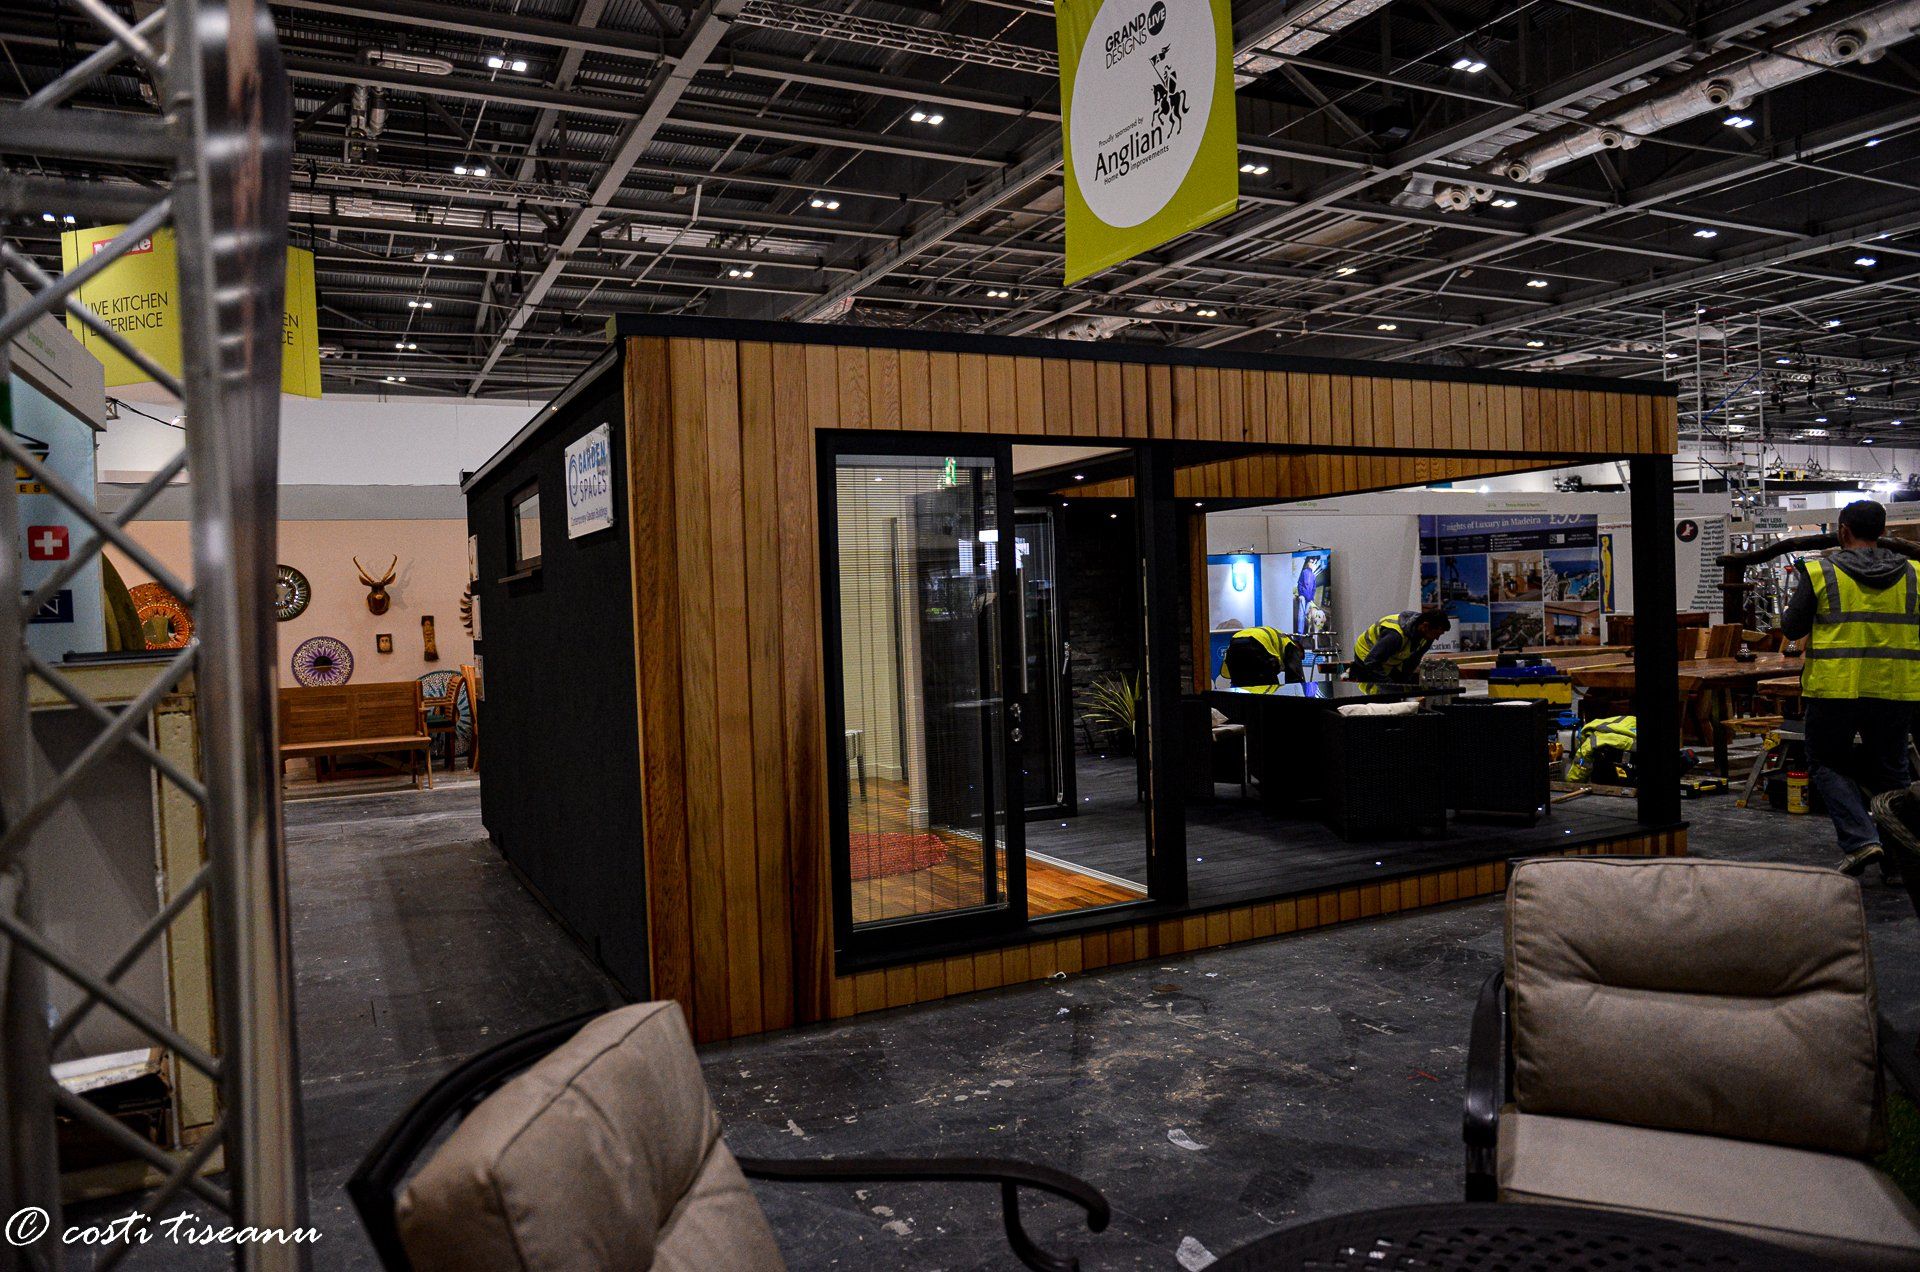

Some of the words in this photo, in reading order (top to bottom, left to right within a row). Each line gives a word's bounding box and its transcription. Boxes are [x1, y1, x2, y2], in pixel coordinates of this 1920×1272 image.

[1105, 12, 1146, 53] GRAND
[1149, 7, 1166, 28] LIVE
[1105, 28, 1147, 69] DESIGNS
[1098, 132, 1115, 147] Proudly
[1114, 120, 1137, 140] sponsored
[1137, 116, 1144, 127] by
[1095, 126, 1163, 181] Anglian
[1104, 173, 1119, 186] Home
[112, 291, 168, 314] KITCHEN
[578, 440, 607, 474] GARDEN
[579, 471, 607, 502] SPACES
[1467, 520, 1474, 529] of
[1475, 519, 1500, 529] Luxury
[1501, 519, 1509, 527] in
[1511, 516, 1541, 526] Madeira
